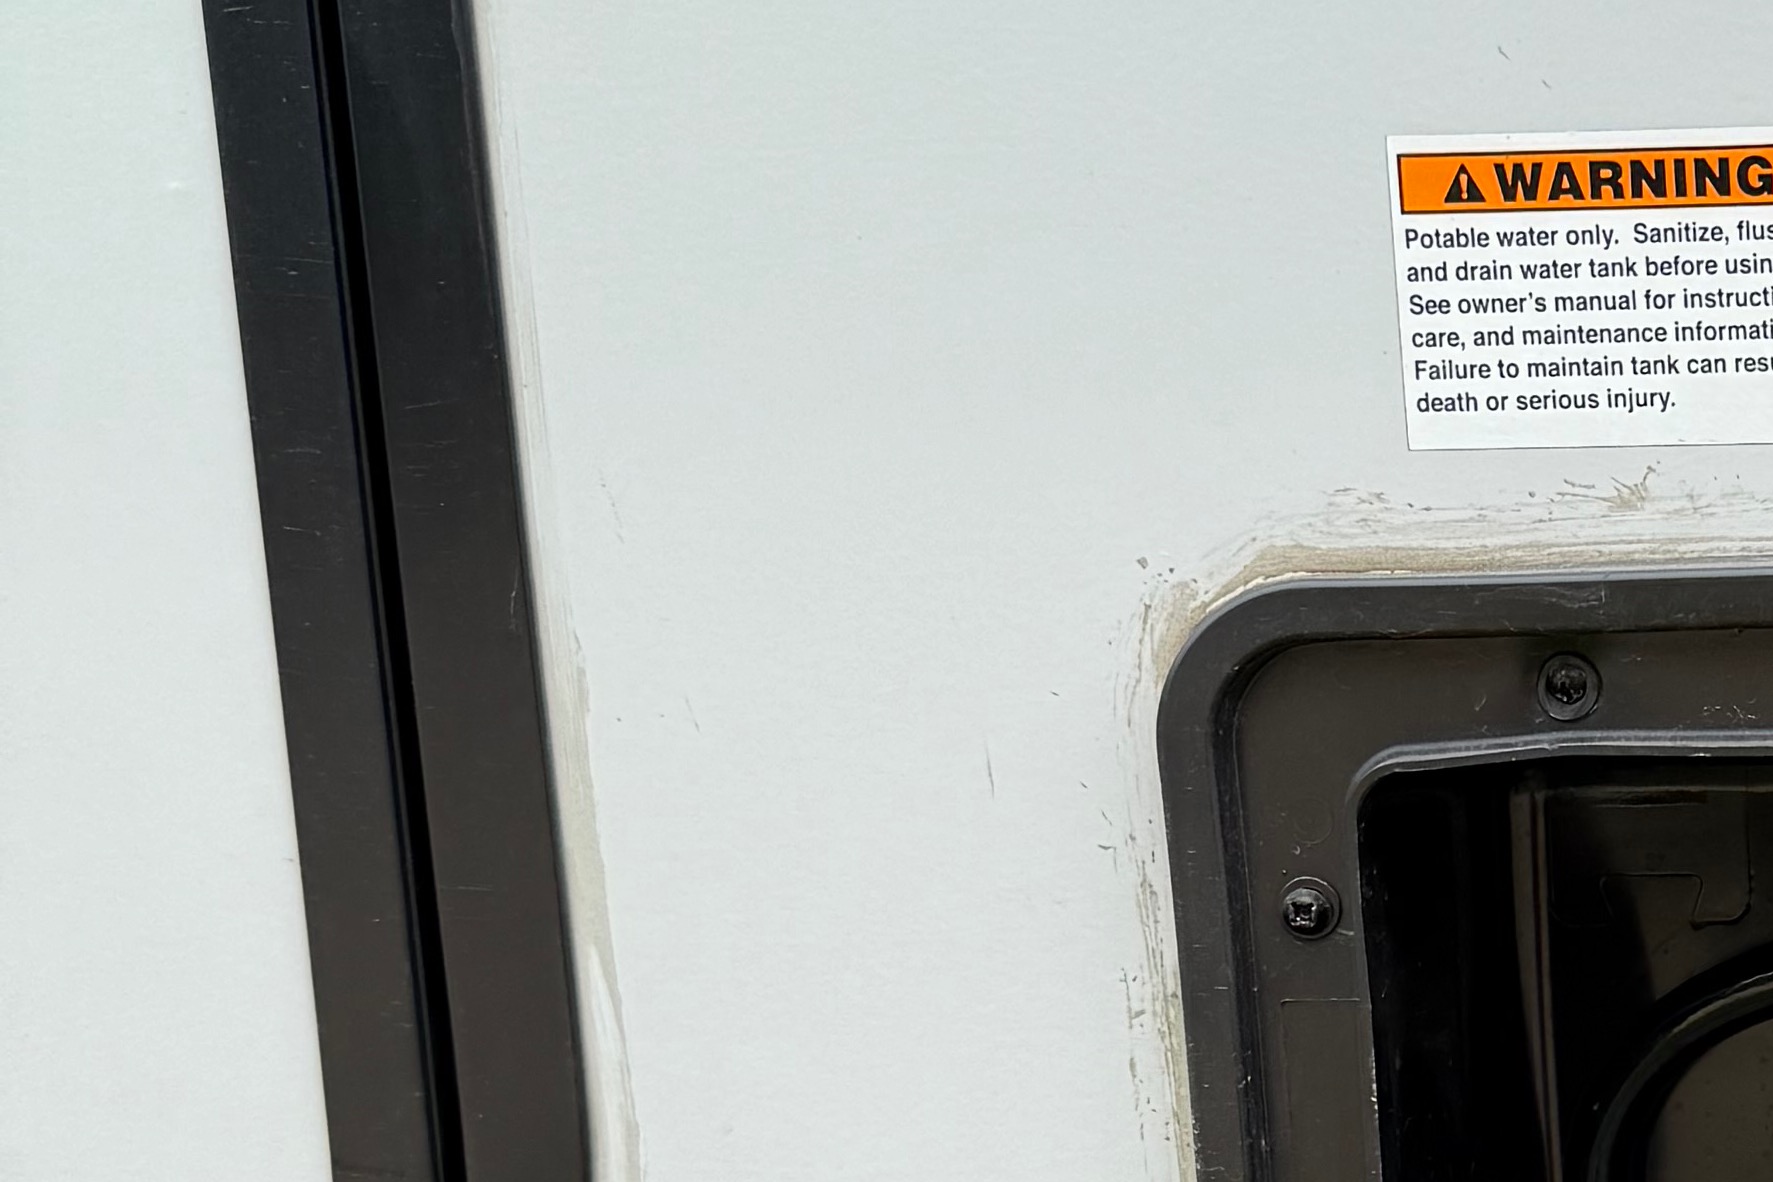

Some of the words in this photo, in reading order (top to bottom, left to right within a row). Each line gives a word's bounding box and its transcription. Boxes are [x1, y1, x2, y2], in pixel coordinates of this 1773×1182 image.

[1404, 227, 1490, 250] Potable
[1495, 227, 1559, 247] water
[1565, 224, 1619, 251] only.
[1633, 221, 1730, 246] Sanitize,
[1407, 260, 1448, 283] and
[1455, 259, 1513, 282] drain
[1519, 259, 1582, 280] water
[1588, 256, 1638, 279] tank
[1645, 255, 1718, 277] before
[1409, 294, 1451, 316] See
[1457, 291, 1547, 315] owner's
[1554, 289, 1637, 313] manual
[1643, 288, 1676, 311] for
[1411, 331, 1466, 351] care,
[1473, 325, 1515, 347] and
[1522, 323, 1668, 346] maintenance
[1414, 359, 1492, 381] Failure
[1497, 359, 1520, 379] to
[1527, 355, 1624, 378] maintain
[1630, 354, 1680, 377] tank
[1687, 357, 1727, 375] can
[1416, 391, 1478, 413] death
[1485, 395, 1509, 412] or
[1516, 388, 1600, 411] serious
[1607, 387, 1676, 414] injury.
